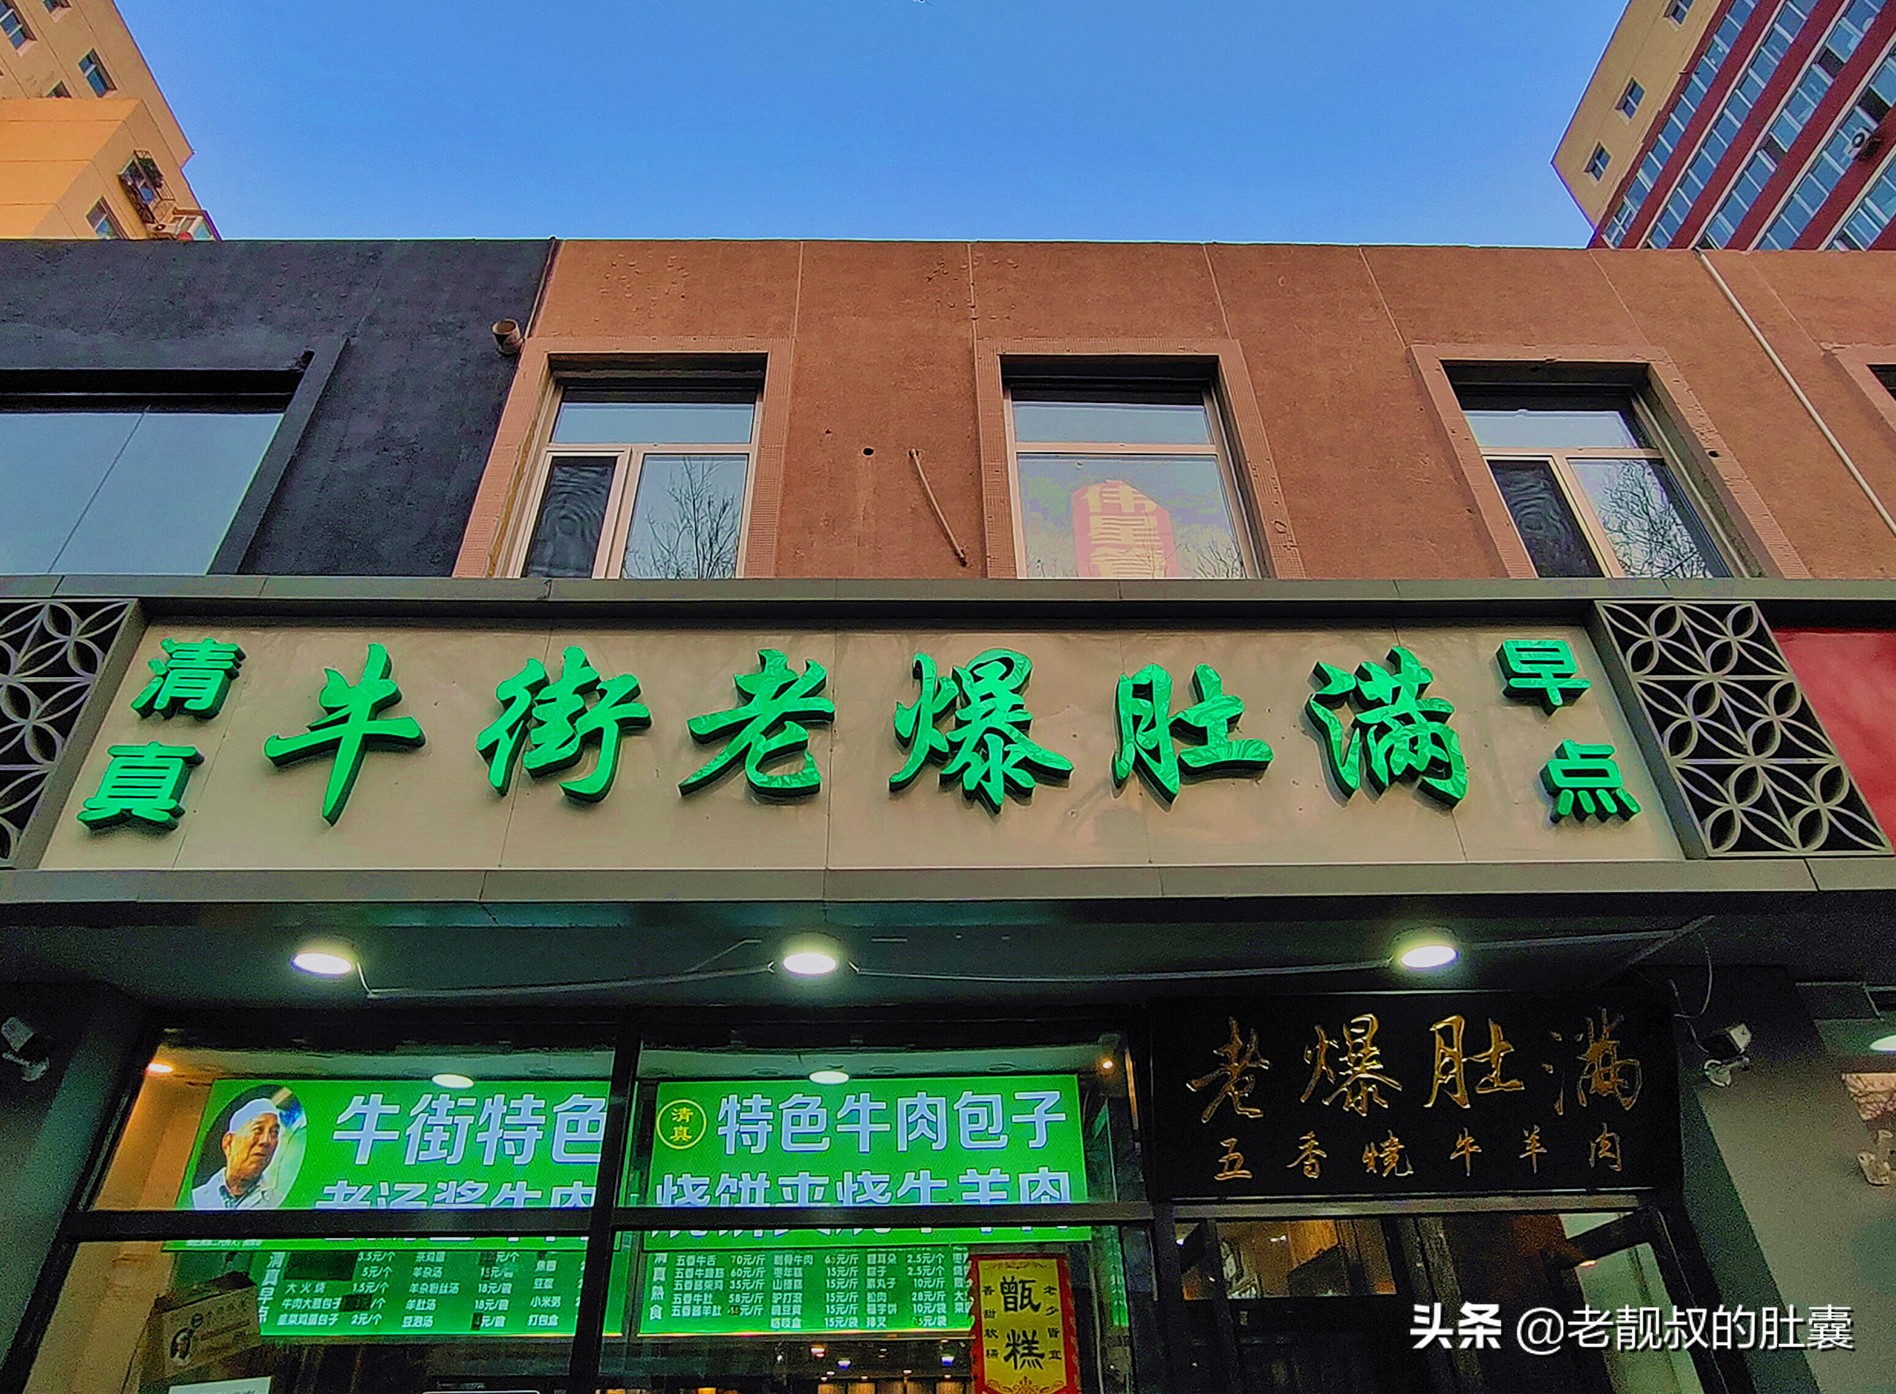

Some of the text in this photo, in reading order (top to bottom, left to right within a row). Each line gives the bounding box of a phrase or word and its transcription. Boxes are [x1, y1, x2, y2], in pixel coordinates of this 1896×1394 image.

[76, 636, 246, 830] 清真
[264, 642, 1470, 825] 牛街老爆肚满
[1495, 638, 1642, 822] 早点
[717, 1090, 1067, 1154] 特色牛肉包子
[1186, 1008, 1643, 1122] 老爆肚满
[332, 1093, 609, 1165] 牛街特色
[669, 1106, 694, 1143] 清真
